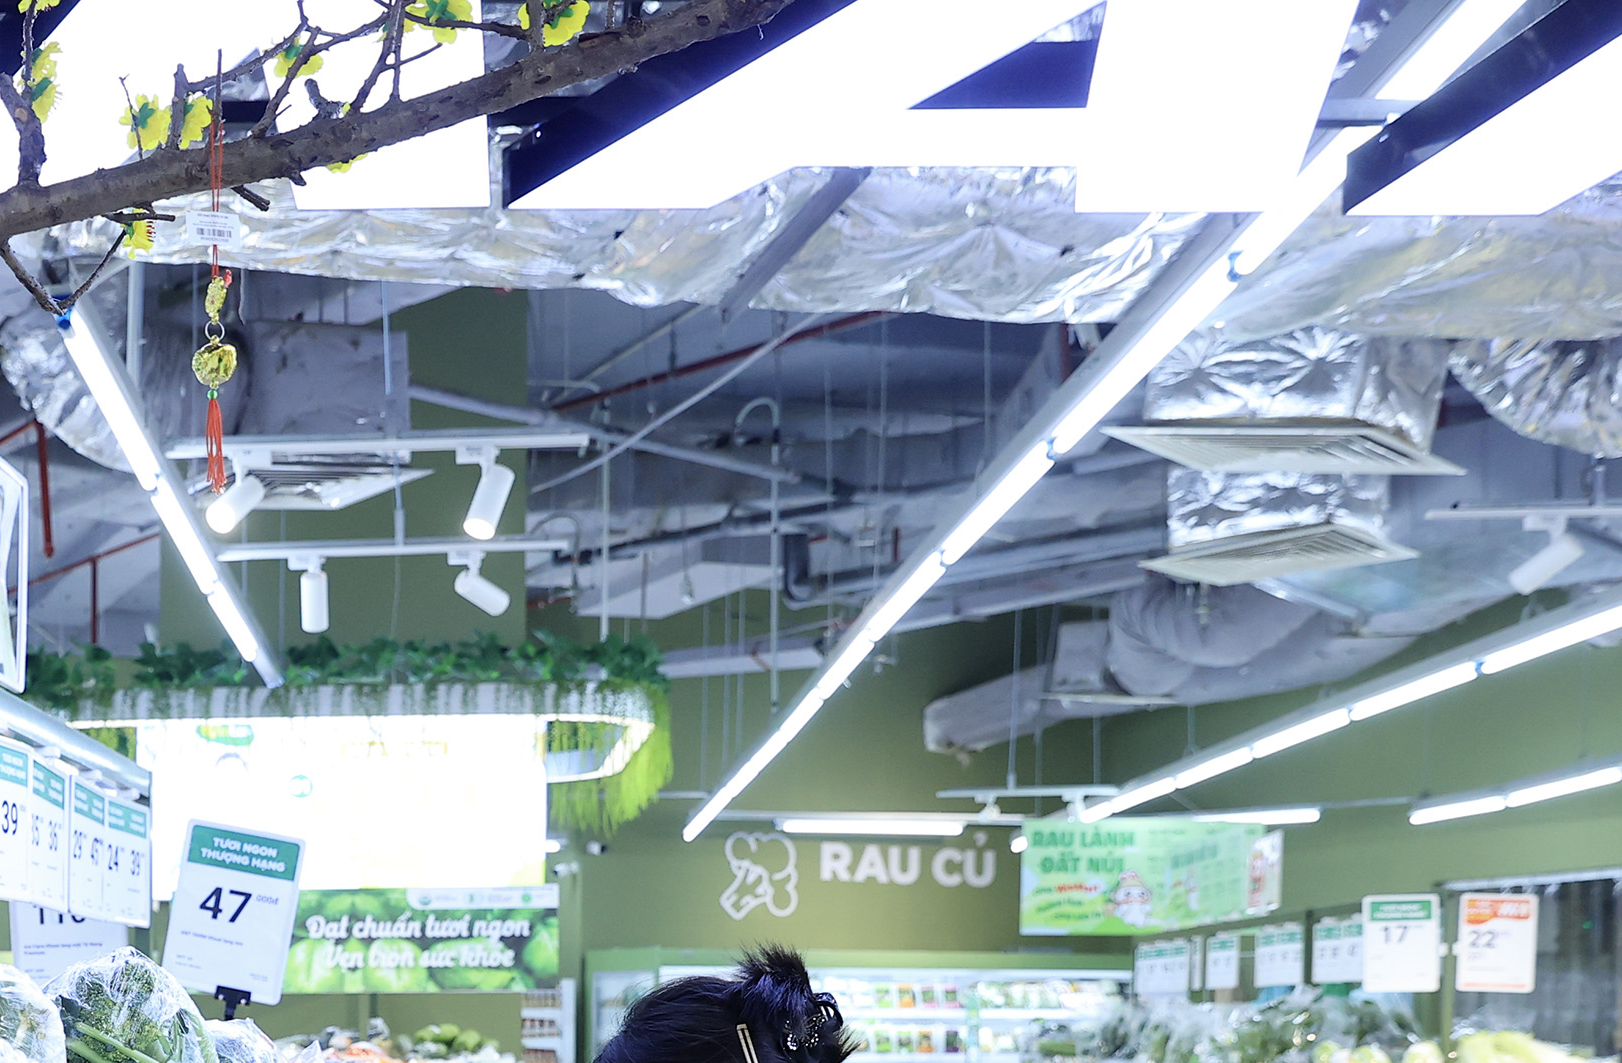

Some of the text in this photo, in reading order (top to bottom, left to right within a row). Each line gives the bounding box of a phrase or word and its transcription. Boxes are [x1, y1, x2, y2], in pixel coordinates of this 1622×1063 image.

[2, 800, 18, 835] 39
[201, 848, 286, 872] THƯỢNG HẠNG
[213, 837, 278, 858] TƯƠI NGON
[820, 830, 996, 887] RAU CỦ
[199, 887, 252, 923] 47
